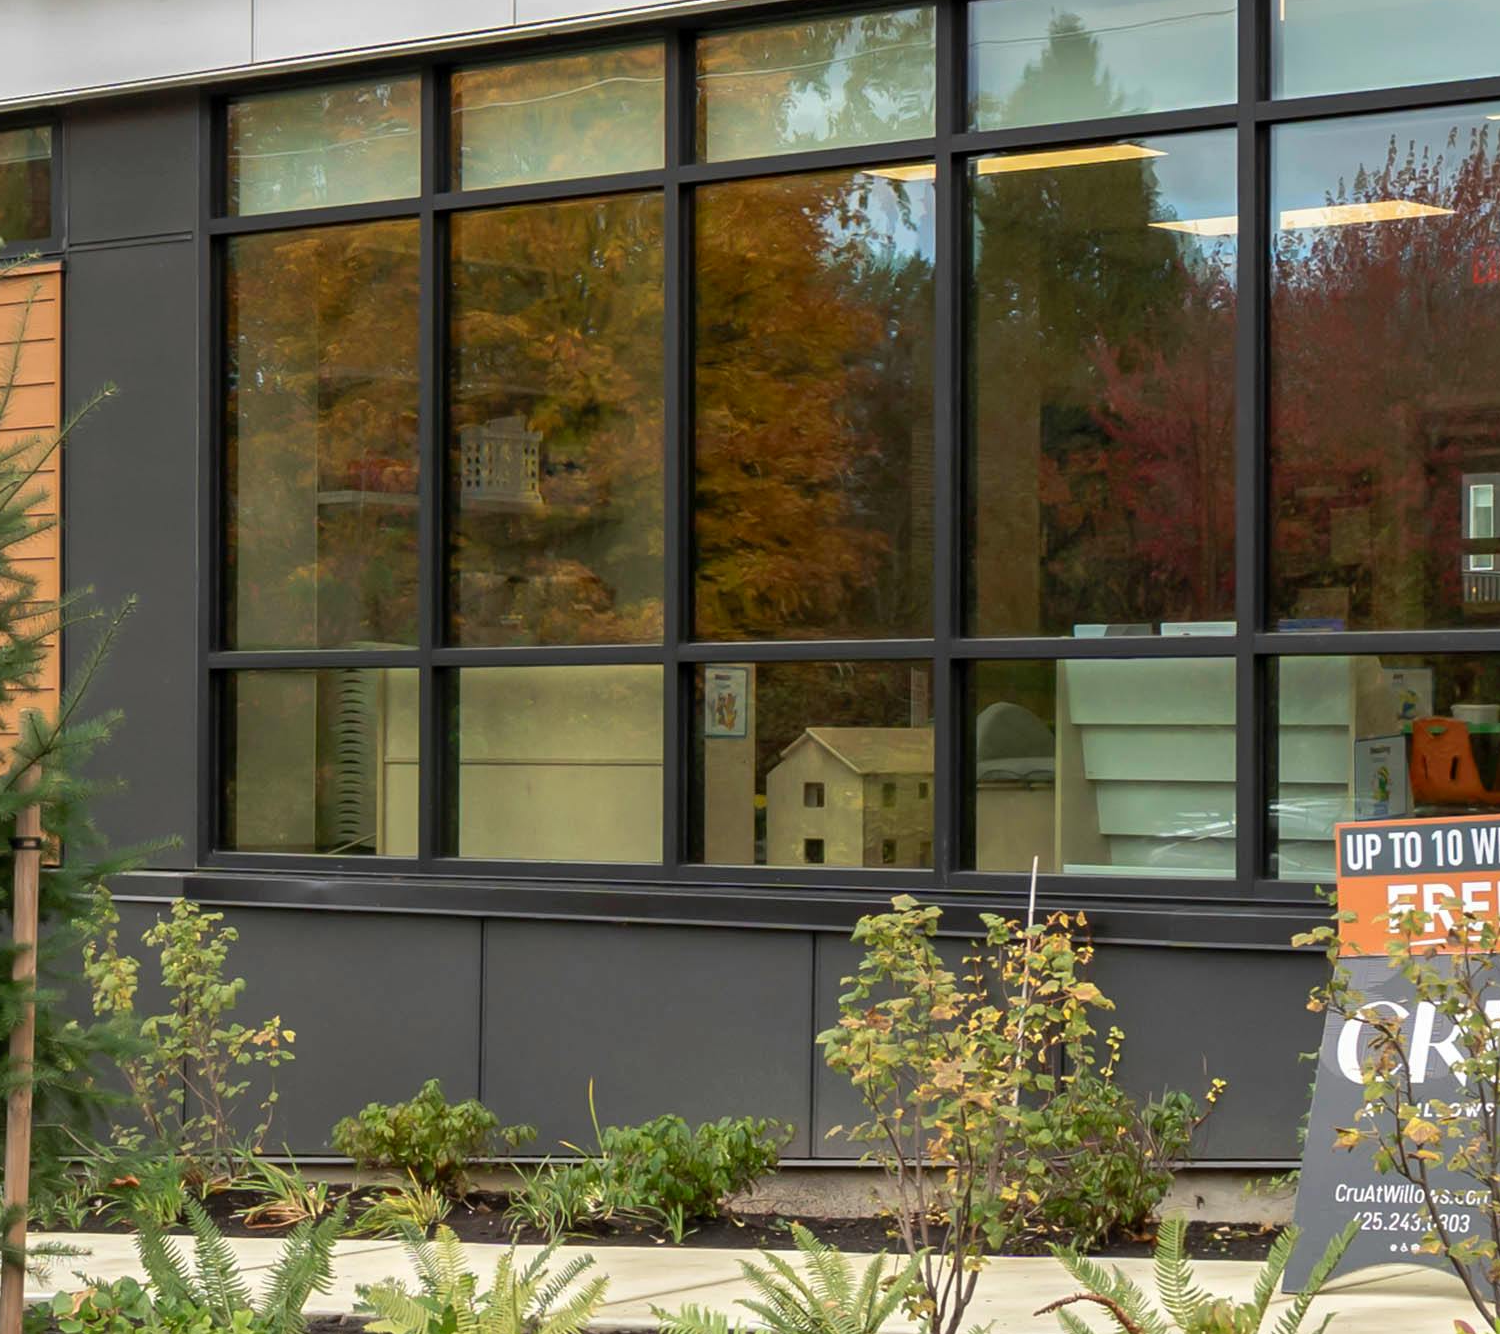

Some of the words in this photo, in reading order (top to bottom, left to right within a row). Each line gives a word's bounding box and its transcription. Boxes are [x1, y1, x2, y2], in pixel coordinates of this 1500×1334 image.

[1346, 833, 1382, 870] UP
[1388, 831, 1422, 868] TO
[1431, 829, 1463, 866] 10
